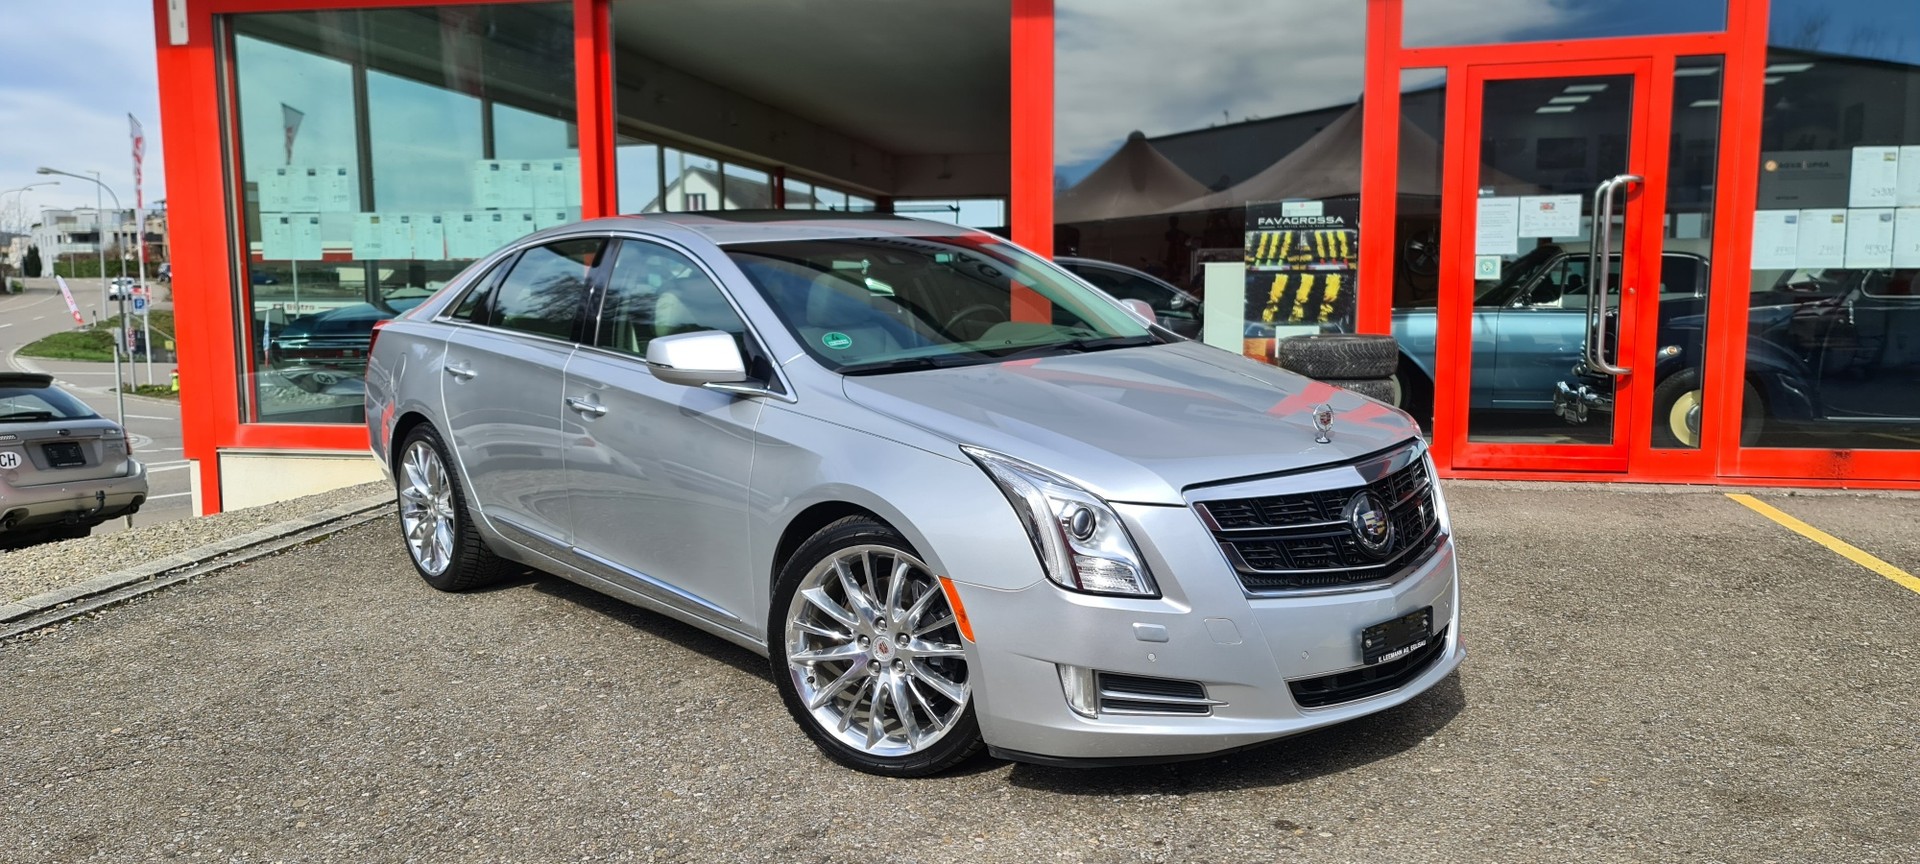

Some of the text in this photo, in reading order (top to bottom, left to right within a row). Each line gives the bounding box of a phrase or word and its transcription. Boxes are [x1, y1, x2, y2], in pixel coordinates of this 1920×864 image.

[1258, 216, 1344, 225] FAVAGROSSA
[0, 454, 16, 467] CH
[1382, 649, 1403, 661] LEEMANN
